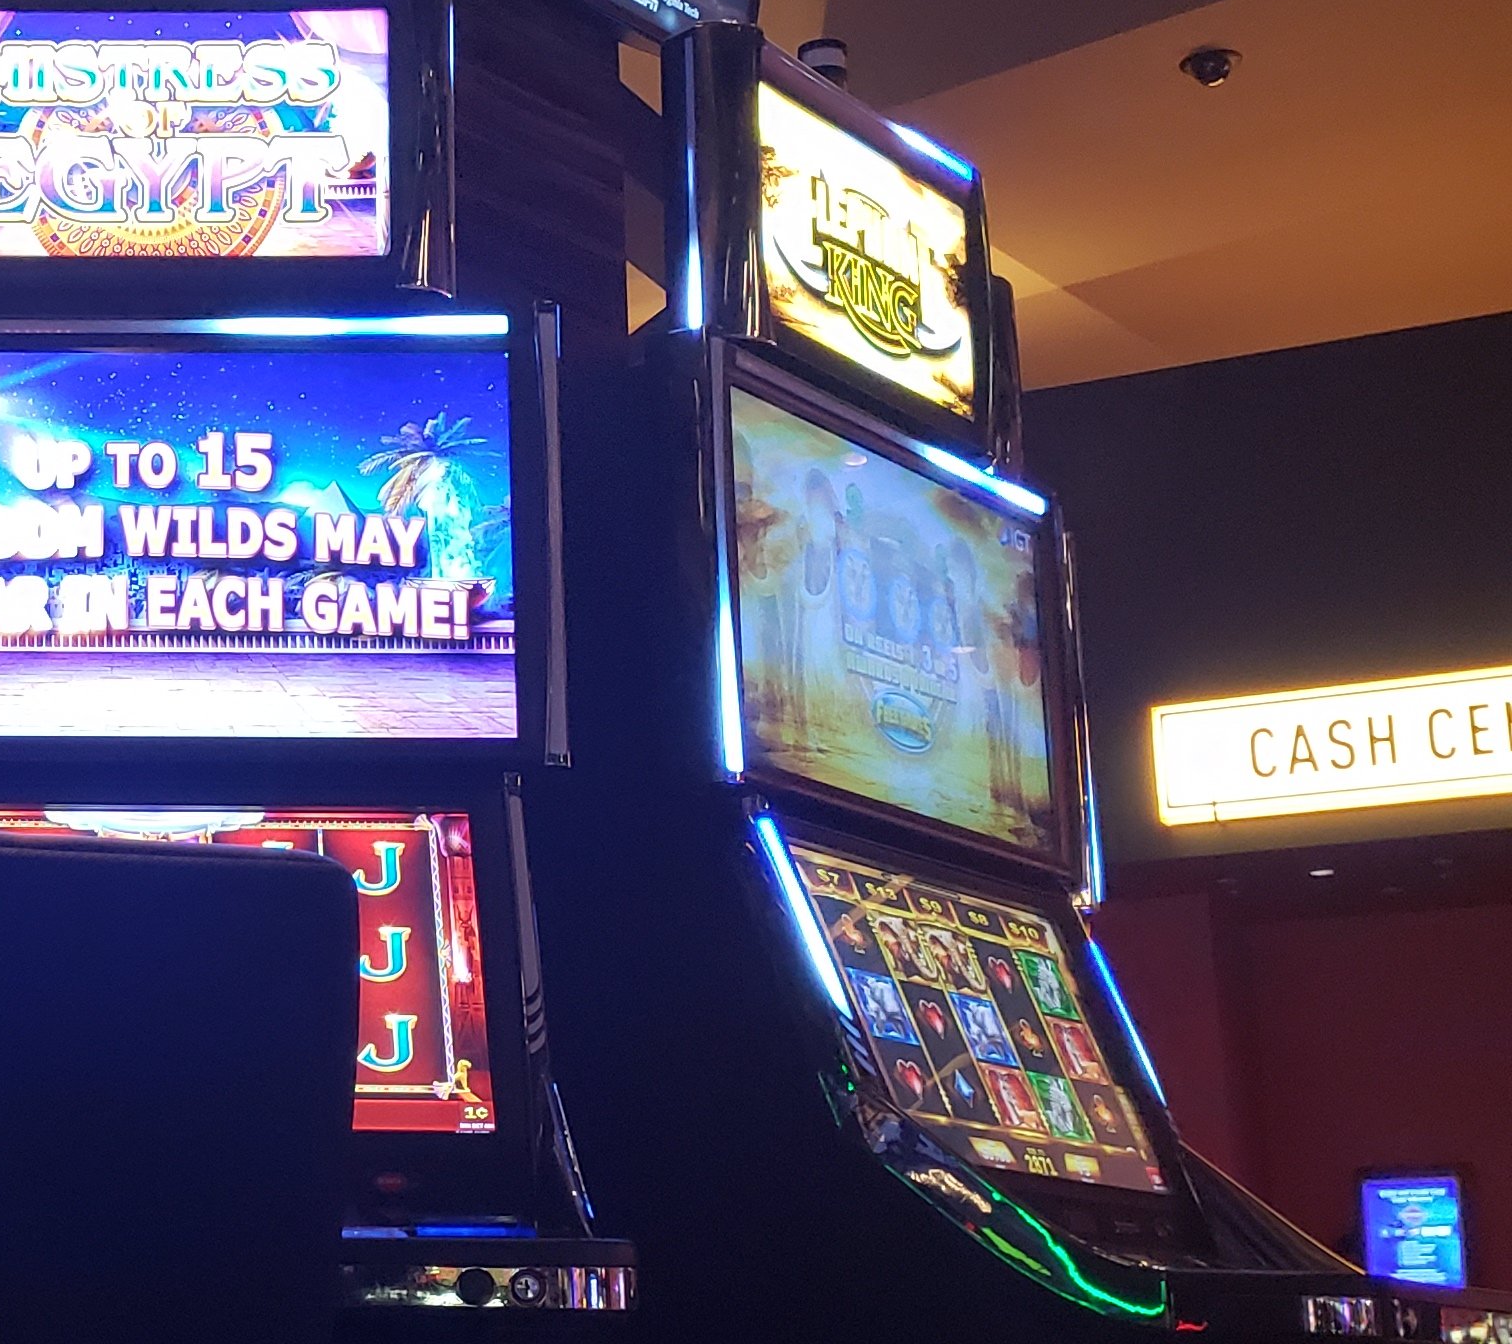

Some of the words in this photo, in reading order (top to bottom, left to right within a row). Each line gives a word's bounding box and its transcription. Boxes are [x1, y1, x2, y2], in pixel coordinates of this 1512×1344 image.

[684, 2, 700, 20] Tech
[118, 100, 188, 138] OF
[821, 240, 923, 358] KING
[13, 435, 91, 491] UP
[104, 441, 178, 489] TO
[197, 431, 273, 492] 15
[119, 504, 298, 562] WILDS
[313, 511, 426, 568] MAY
[58, 574, 130, 634] IN
[146, 575, 285, 632] EACH
[300, 581, 471, 641] GAME!
[1250, 714, 1398, 778] CASH
[816, 868, 840, 886] $7
[1008, 922, 1039, 940] $10
[463, 1106, 489, 1120] 1¢
